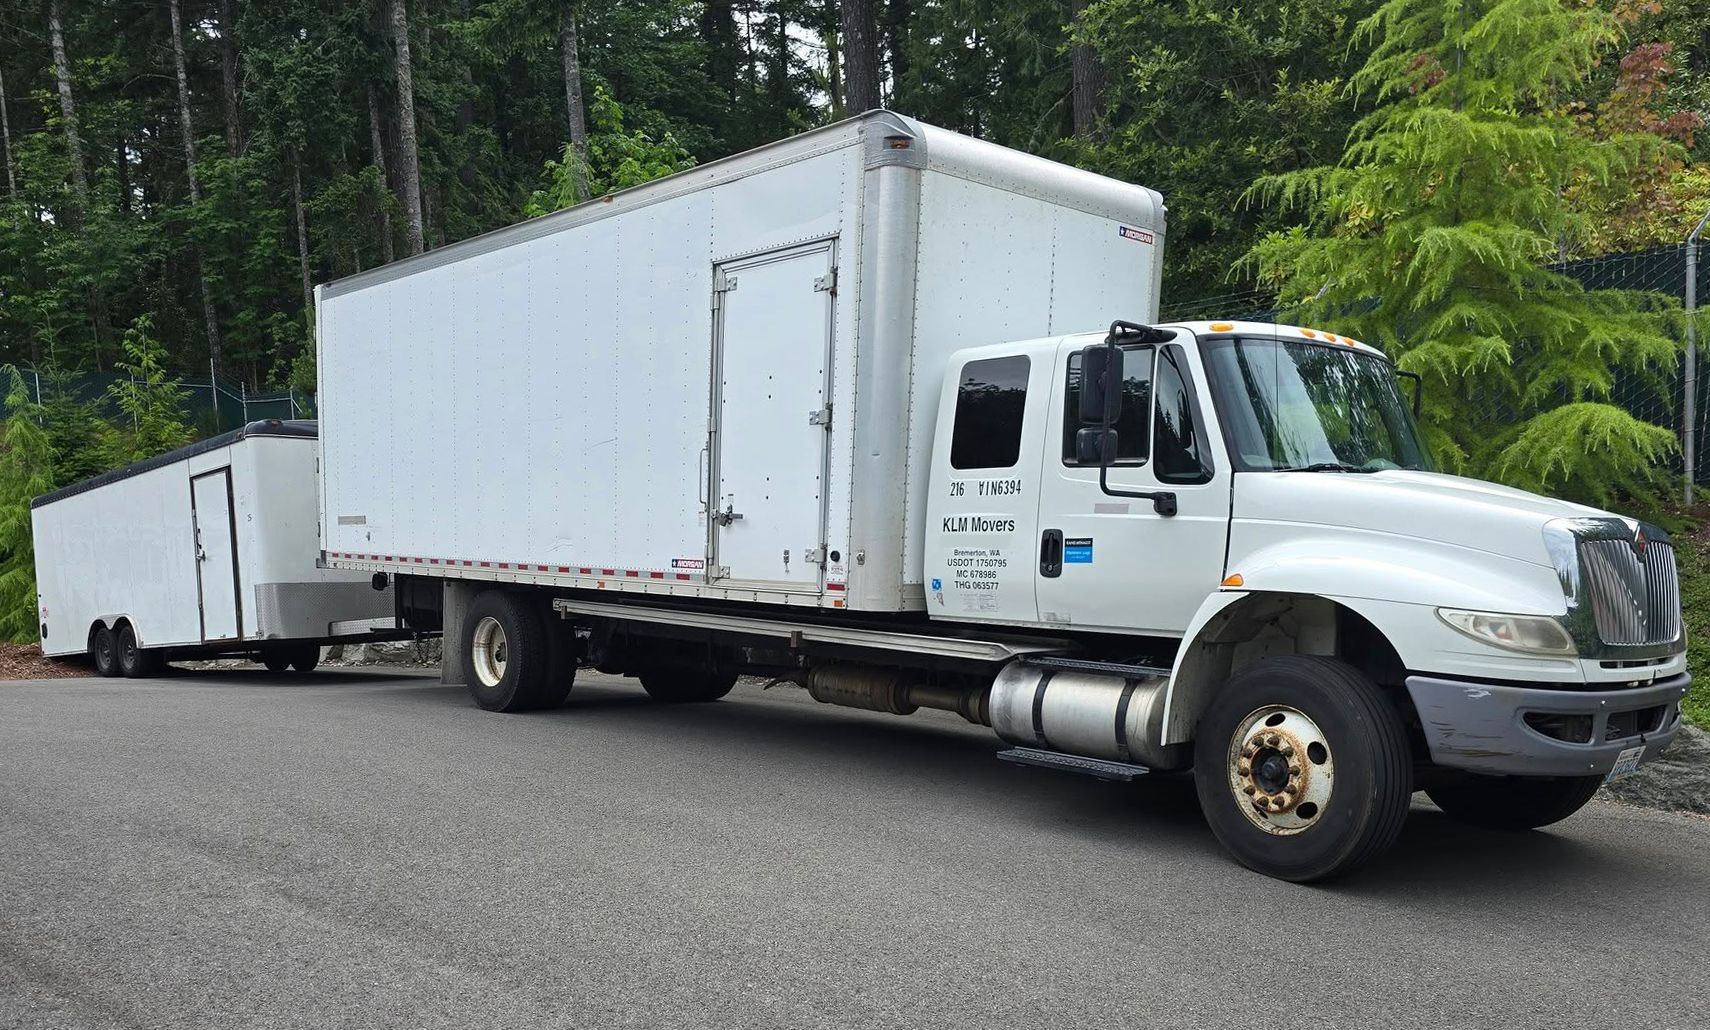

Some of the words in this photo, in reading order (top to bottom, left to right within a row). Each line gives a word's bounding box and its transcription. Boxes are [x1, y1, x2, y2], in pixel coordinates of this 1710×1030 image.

[950, 482, 965, 497] 216
[943, 517, 968, 533] KLM
[971, 517, 1015, 532] Movers
[954, 549, 988, 558] Bremerton,
[989, 549, 1001, 557] WA
[676, 560, 703, 569] MORGAN
[947, 558, 974, 567] USDOT
[976, 559, 1007, 567] 1750795
[956, 570, 969, 578] MC
[970, 570, 997, 579] 678986
[954, 581, 971, 589] THG
[973, 581, 999, 590] 063577
